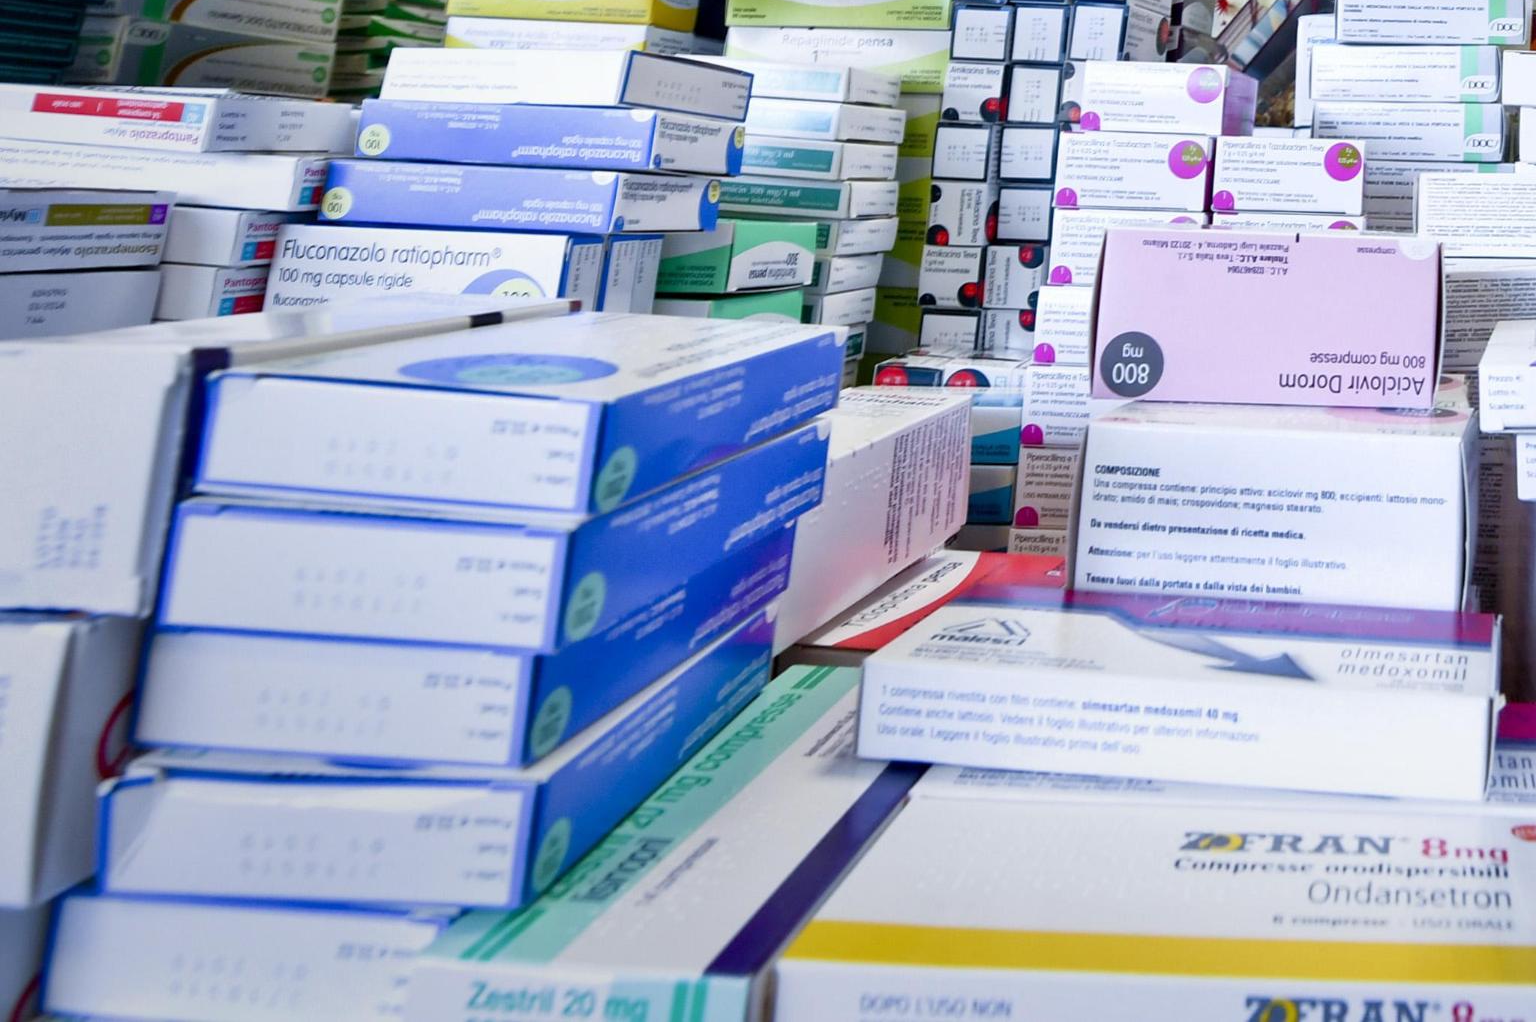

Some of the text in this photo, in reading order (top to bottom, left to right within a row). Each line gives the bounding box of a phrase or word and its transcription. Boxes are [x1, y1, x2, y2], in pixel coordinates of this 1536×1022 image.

[1497, 22, 1517, 32] DOC
[857, 37, 894, 48] pensa
[1467, 80, 1489, 90] DOC
[130, 130, 198, 145] Pantoprazolo
[1472, 139, 1493, 149] DOC
[579, 148, 640, 163] Fluconazolo
[540, 211, 601, 227] Fluconazolo
[75, 243, 159, 256] Esomeprazolo
[283, 239, 386, 263] Fluconazolo
[1143, 239, 1289, 253] Piazzale Luigi Milano
[1356, 245, 1396, 256] compresse
[1217, 253, 1234, 262] Teva
[278, 267, 413, 289] 100 mg capsule rigide
[1122, 342, 1143, 359] mg
[1310, 352, 1426, 369] 800 mg compresse
[1112, 362, 1150, 384] 800
[1279, 373, 1426, 396] Aciclovir Dorom
[1095, 465, 1160, 478] COMPOSIZIONE
[1093, 479, 1109, 489] Una
[1111, 480, 1157, 493] compressa
[1200, 483, 1238, 498] principio
[1267, 488, 1304, 499] aciclovir
[1305, 492, 1319, 502] mg
[1386, 494, 1418, 505] lattosio
[1120, 495, 1146, 506] amido
[1148, 496, 1156, 506] di
[1243, 500, 1284, 513] magnesio
[1091, 519, 1306, 540] Da vendersi dietro presentazione di ricetta medica.
[1136, 550, 1150, 562] per
[1175, 552, 1207, 565] leggere
[1209, 554, 1265, 567] attentamente
[1267, 557, 1274, 566] il
[1275, 557, 1299, 570] foglio
[921, 562, 963, 583] pensa
[1086, 573, 1115, 585] Tenere
[1117, 577, 1137, 588] fuori
[1139, 578, 1160, 588] dalla
[1162, 579, 1193, 591] portata
[1203, 581, 1225, 591] dalla
[1227, 583, 1248, 593] vista
[1250, 584, 1264, 594] dei
[1266, 584, 1303, 596] bambini.
[930, 633, 1027, 646] malesci
[1340, 647, 1469, 666] olmesartan
[1336, 661, 1468, 682] medoxomil
[882, 685, 889, 696] 1
[890, 687, 945, 700] compressa
[947, 690, 986, 703] rivestita
[989, 694, 1010, 704] con
[1011, 694, 1030, 706] film
[1082, 699, 1141, 714] olmesartan
[1143, 703, 1203, 718] medoxomil
[1205, 708, 1219, 719] 40
[1222, 711, 1240, 723] mg
[880, 703, 1193, 739] Contiene anche Vedere il foglio illustrativo per ulteriori
[694, 693, 803, 771] compresse
[877, 722, 1099, 751] Uso Leggere il foglio illustrativo prima
[1174, 857, 1508, 879] Compresse orodispersibili
[1307, 880, 1513, 909] Ondansetron
[1291, 915, 1513, 931] compresse USO ORALE
[466, 981, 595, 1018] Zestril 20
